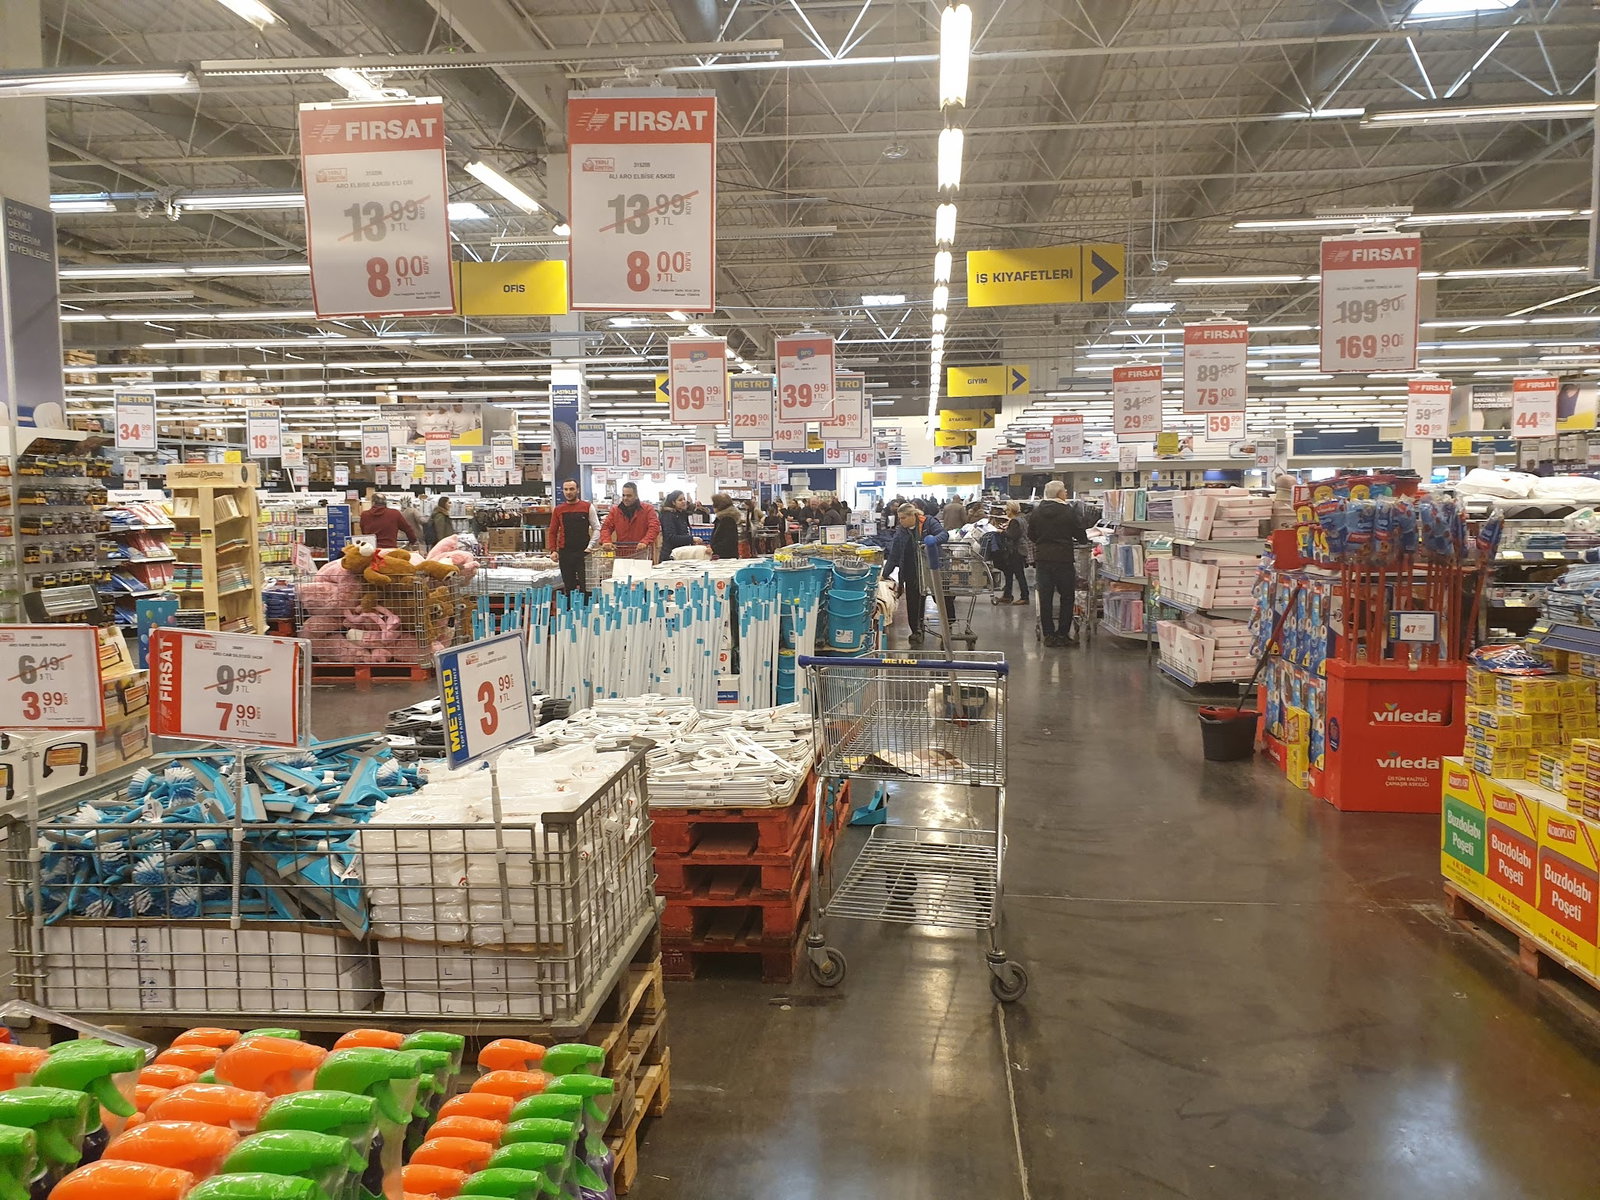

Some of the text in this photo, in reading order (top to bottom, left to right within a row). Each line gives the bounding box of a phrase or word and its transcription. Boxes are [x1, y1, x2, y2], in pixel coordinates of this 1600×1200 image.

[614, 111, 708, 131] FIRSAT
[345, 118, 437, 141] FIRSAT
[344, 200, 418, 242] 13 99
[608, 194, 684, 235] 13 99
[1352, 247, 1416, 262] FIRSAT
[367, 256, 422, 298] 8 00
[627, 251, 684, 292] 8 00
[1336, 300, 1377, 324] 199
[1204, 330, 1245, 339] FIRSAT
[1336, 334, 1400, 359] 169 90
[1128, 370, 1159, 378] FIRSAT
[734, 380, 769, 388] METRO
[836, 380, 859, 388] ETRO
[676, 386, 718, 410] 69 99
[783, 384, 826, 408] 39 99
[1197, 389, 1218, 405] 75
[734, 414, 757, 427] 229
[1124, 416, 1140, 428] 29
[1416, 409, 1431, 420] 59
[1516, 412, 1538, 428] 44
[120, 424, 141, 440] 34
[1209, 416, 1230, 432] 59
[1415, 424, 1429, 435] 39
[253, 435, 267, 448] 18
[775, 430, 791, 440] 149
[365, 446, 379, 458] 29
[622, 450, 630, 462] 9
[827, 449, 840, 458] 99
[856, 454, 867, 462] 49
[1062, 446, 1071, 454] 79
[495, 456, 505, 465] 19
[667, 457, 674, 468] 7
[127, 469, 132, 478] 4
[1404, 625, 1416, 633] 47
[19, 655, 59, 684] 6 49
[159, 638, 173, 702] FIRSAT
[216, 665, 257, 695] 9 99
[21, 692, 62, 720] 3 99
[442, 669, 461, 752] METRO
[478, 680, 498, 735] 3
[498, 674, 510, 691] 99
[216, 702, 256, 731] 7 99
[1373, 709, 1441, 722] vileda
[1376, 756, 1440, 769] vileda
[1448, 810, 1481, 840] Buzdolabı
[1452, 832, 1474, 856] Poşeti
[1491, 834, 1531, 869] Buzdolabı
[1499, 859, 1523, 886] Poşeti
[1544, 863, 1591, 903] Buzdolabı
[1552, 891, 1582, 922] Poşeti
